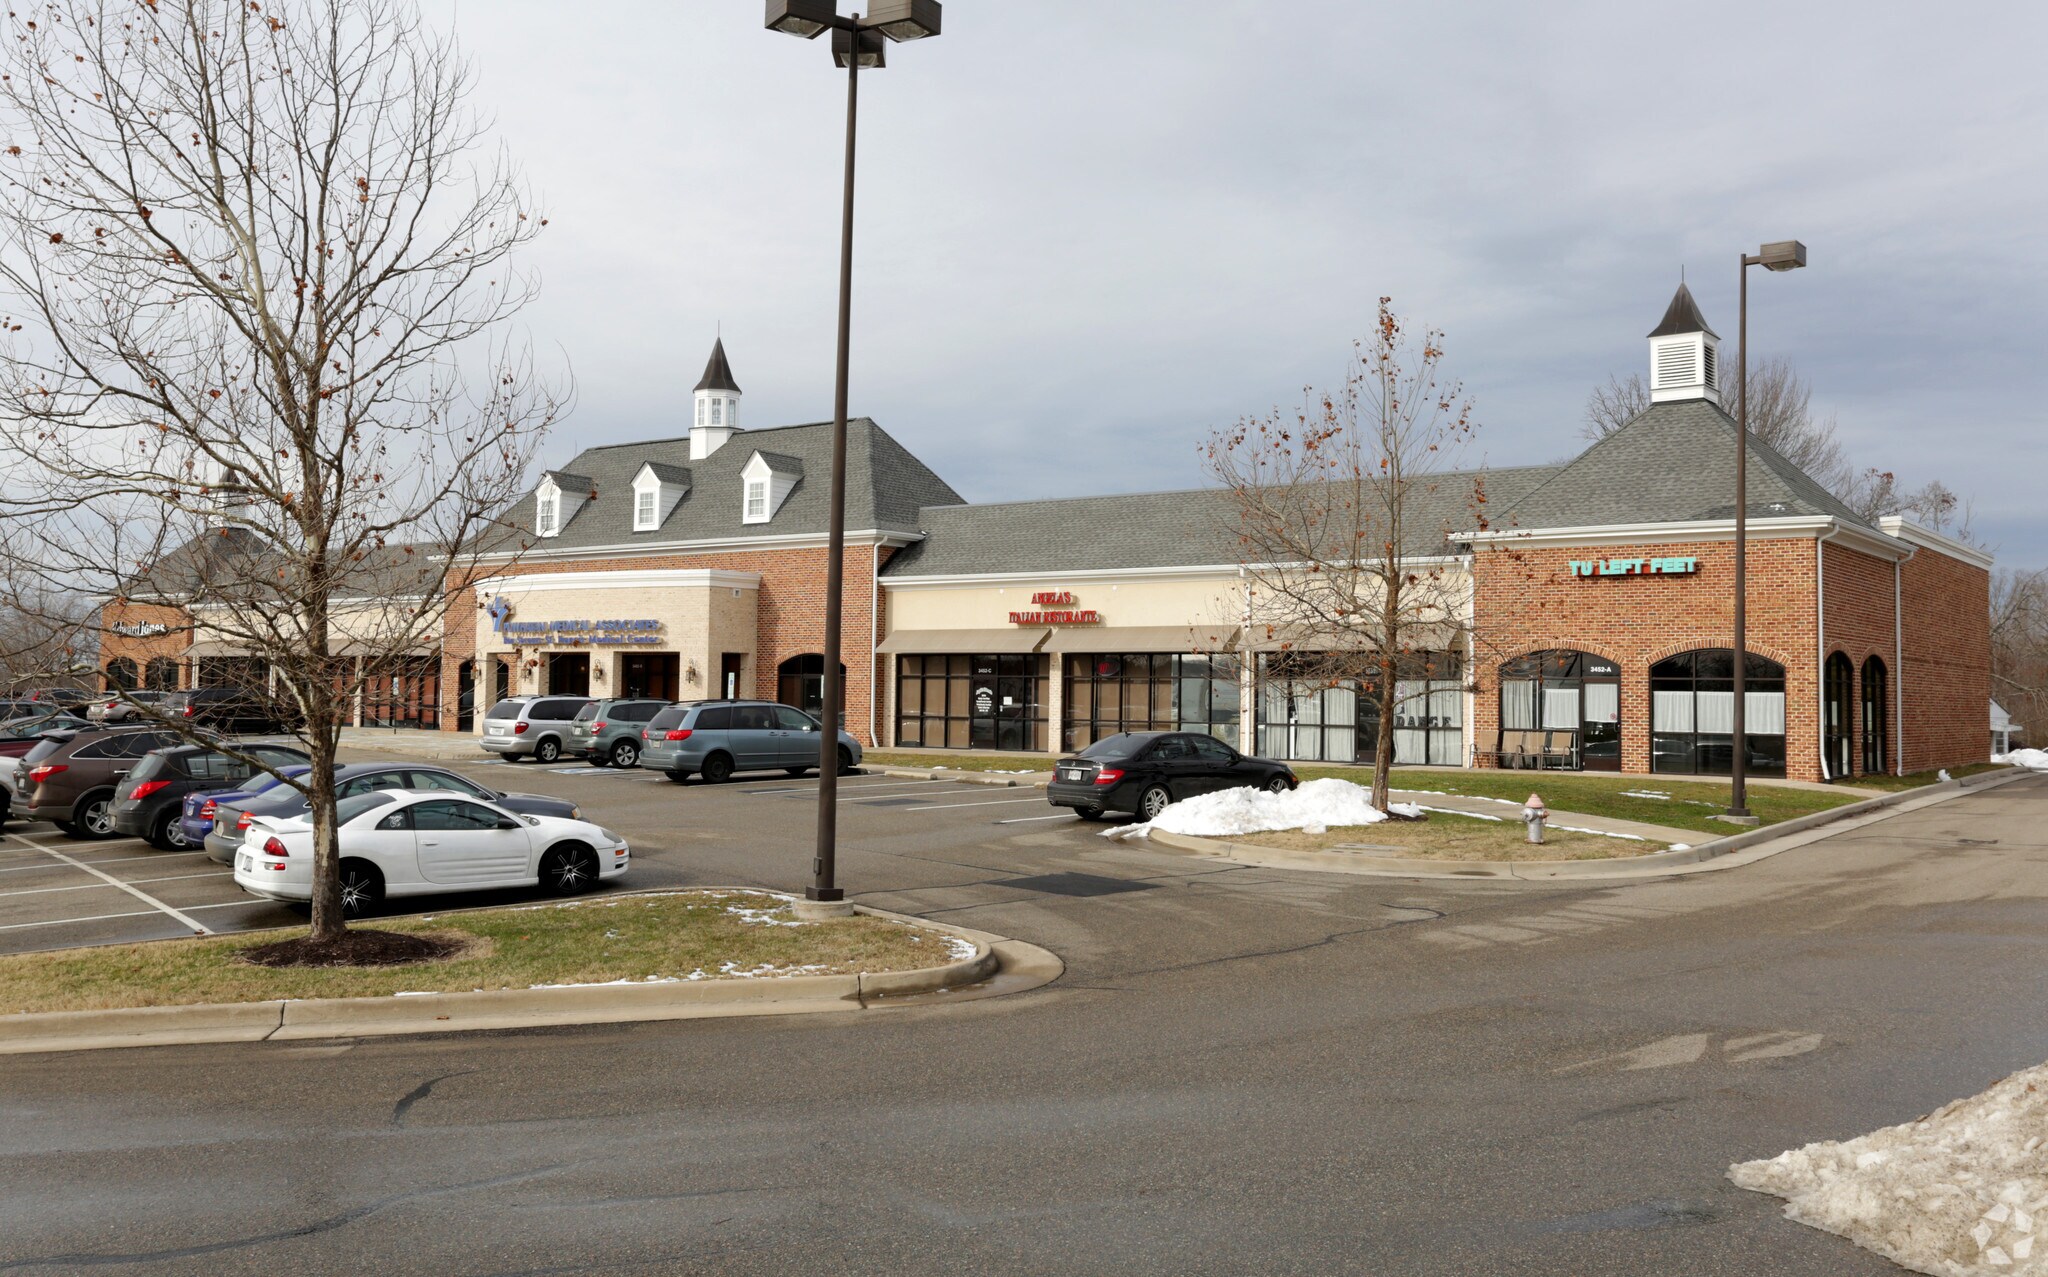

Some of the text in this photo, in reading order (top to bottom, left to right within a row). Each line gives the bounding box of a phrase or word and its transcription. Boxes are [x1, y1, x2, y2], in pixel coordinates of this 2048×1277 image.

[1569, 557, 1697, 576] TU LEFT FEET
[1008, 610, 1099, 624] ITALIAN RISTORANTE
[549, 620, 592, 631] MEDICAL
[594, 619, 660, 631] ASSOCIATES
[589, 634, 622, 644] Medical
[626, 634, 659, 644] Center
